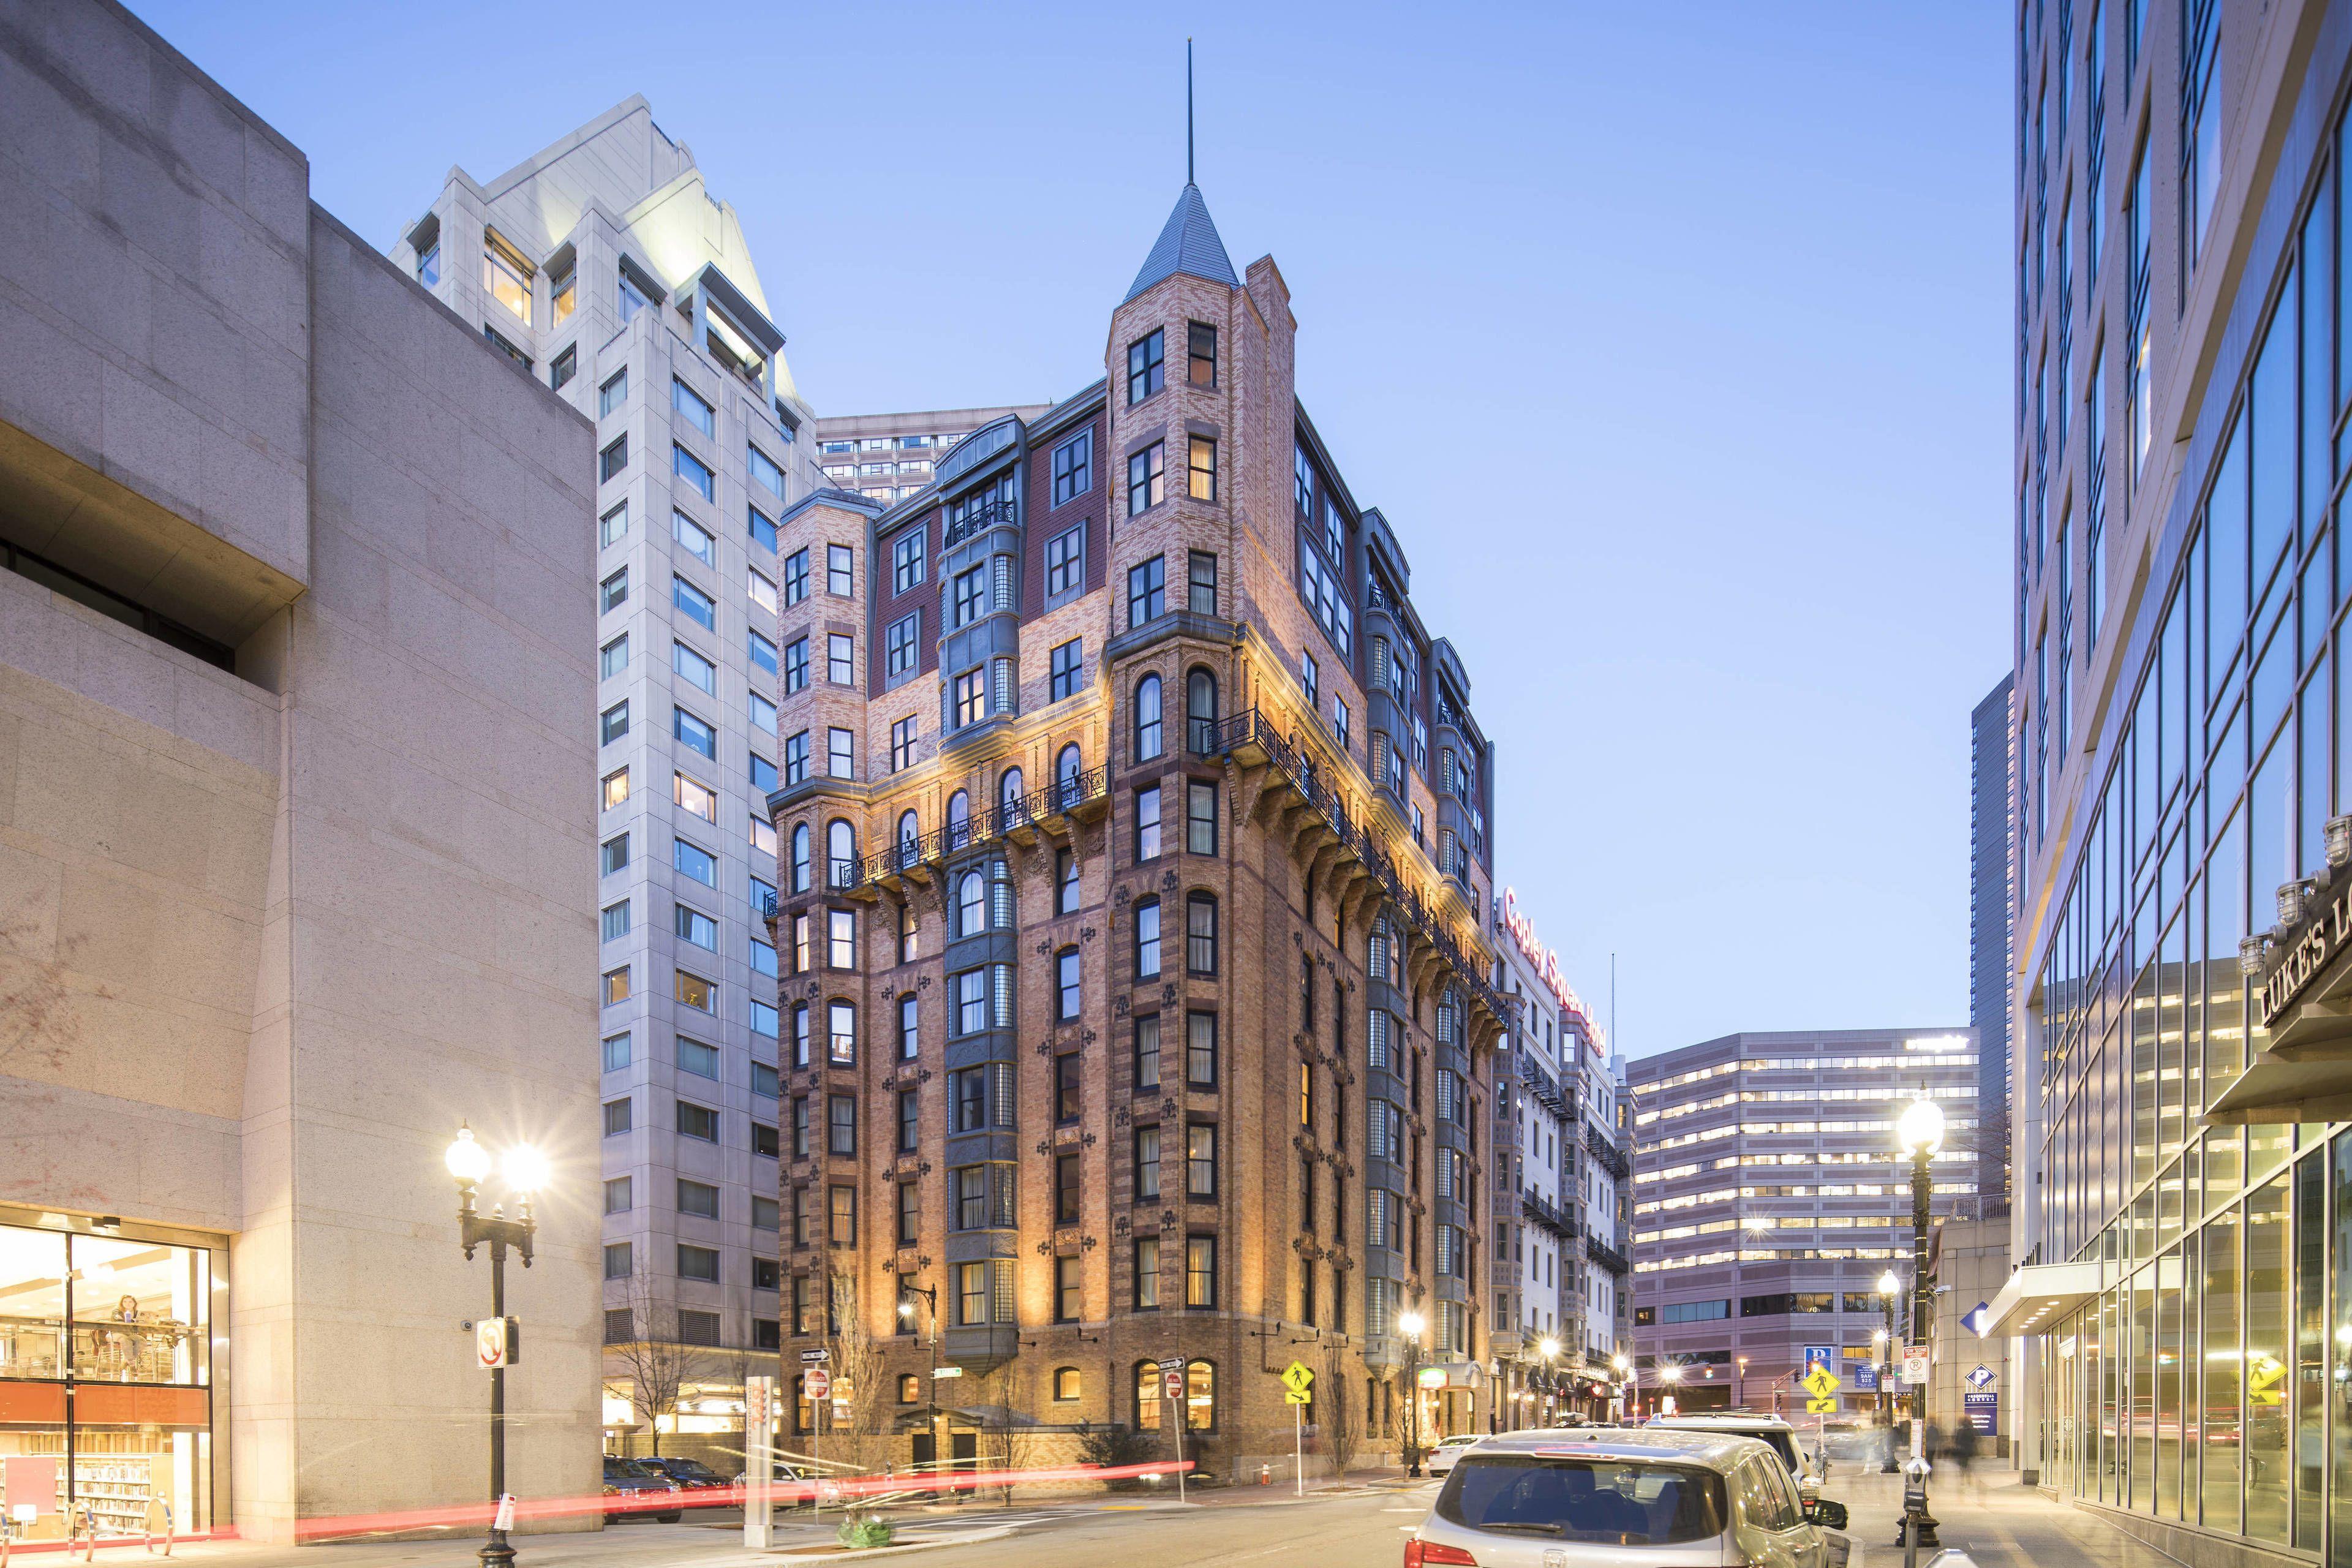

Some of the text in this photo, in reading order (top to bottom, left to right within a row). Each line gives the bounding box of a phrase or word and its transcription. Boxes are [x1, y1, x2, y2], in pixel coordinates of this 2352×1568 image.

[1504, 886, 1607, 1058] Copley Square Hotel
[2260, 880, 2352, 1025] LUKE'S L
[1975, 1370, 1989, 1384] P
